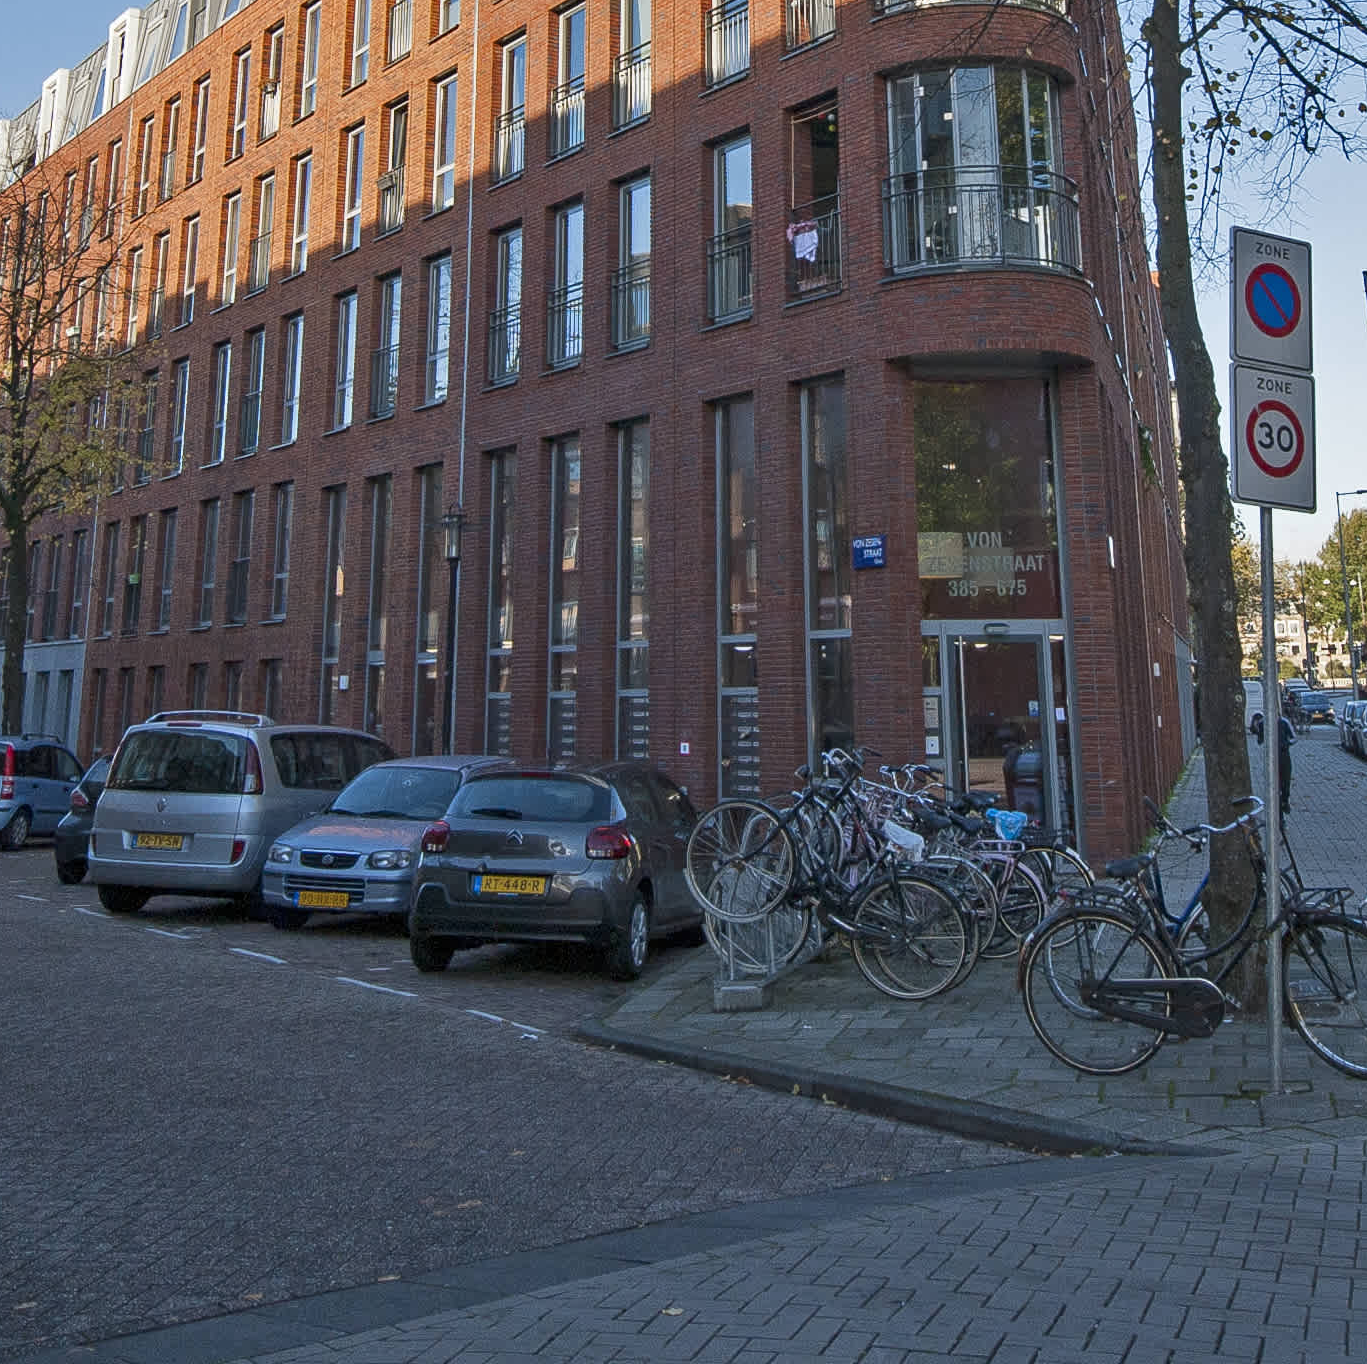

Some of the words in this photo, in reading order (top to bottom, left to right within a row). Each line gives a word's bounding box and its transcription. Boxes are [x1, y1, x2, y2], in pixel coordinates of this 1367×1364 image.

[1255, 242, 1291, 260] ZONE
[1256, 377, 1292, 394] ZONE
[1257, 422, 1294, 453] 30
[852, 539, 865, 549] VON
[967, 531, 1003, 548] VON
[948, 579, 980, 597] 385
[997, 579, 1027, 596] 675
[483, 877, 541, 892] RT-448-R
